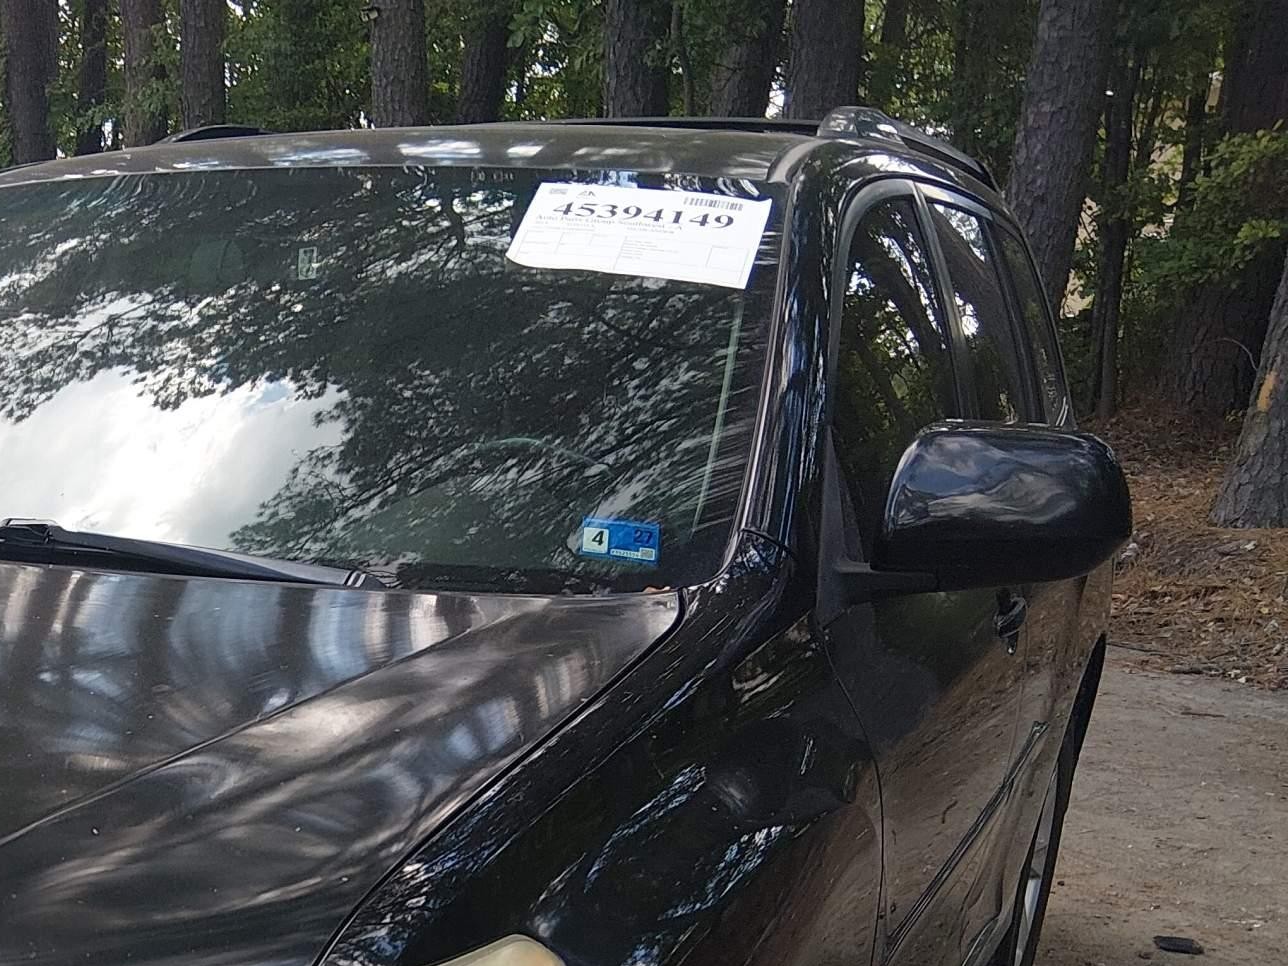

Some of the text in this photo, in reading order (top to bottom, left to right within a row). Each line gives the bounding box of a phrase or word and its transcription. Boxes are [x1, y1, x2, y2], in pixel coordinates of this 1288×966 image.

[553, 201, 735, 229] 45394149
[591, 528, 654, 546] 4 27
